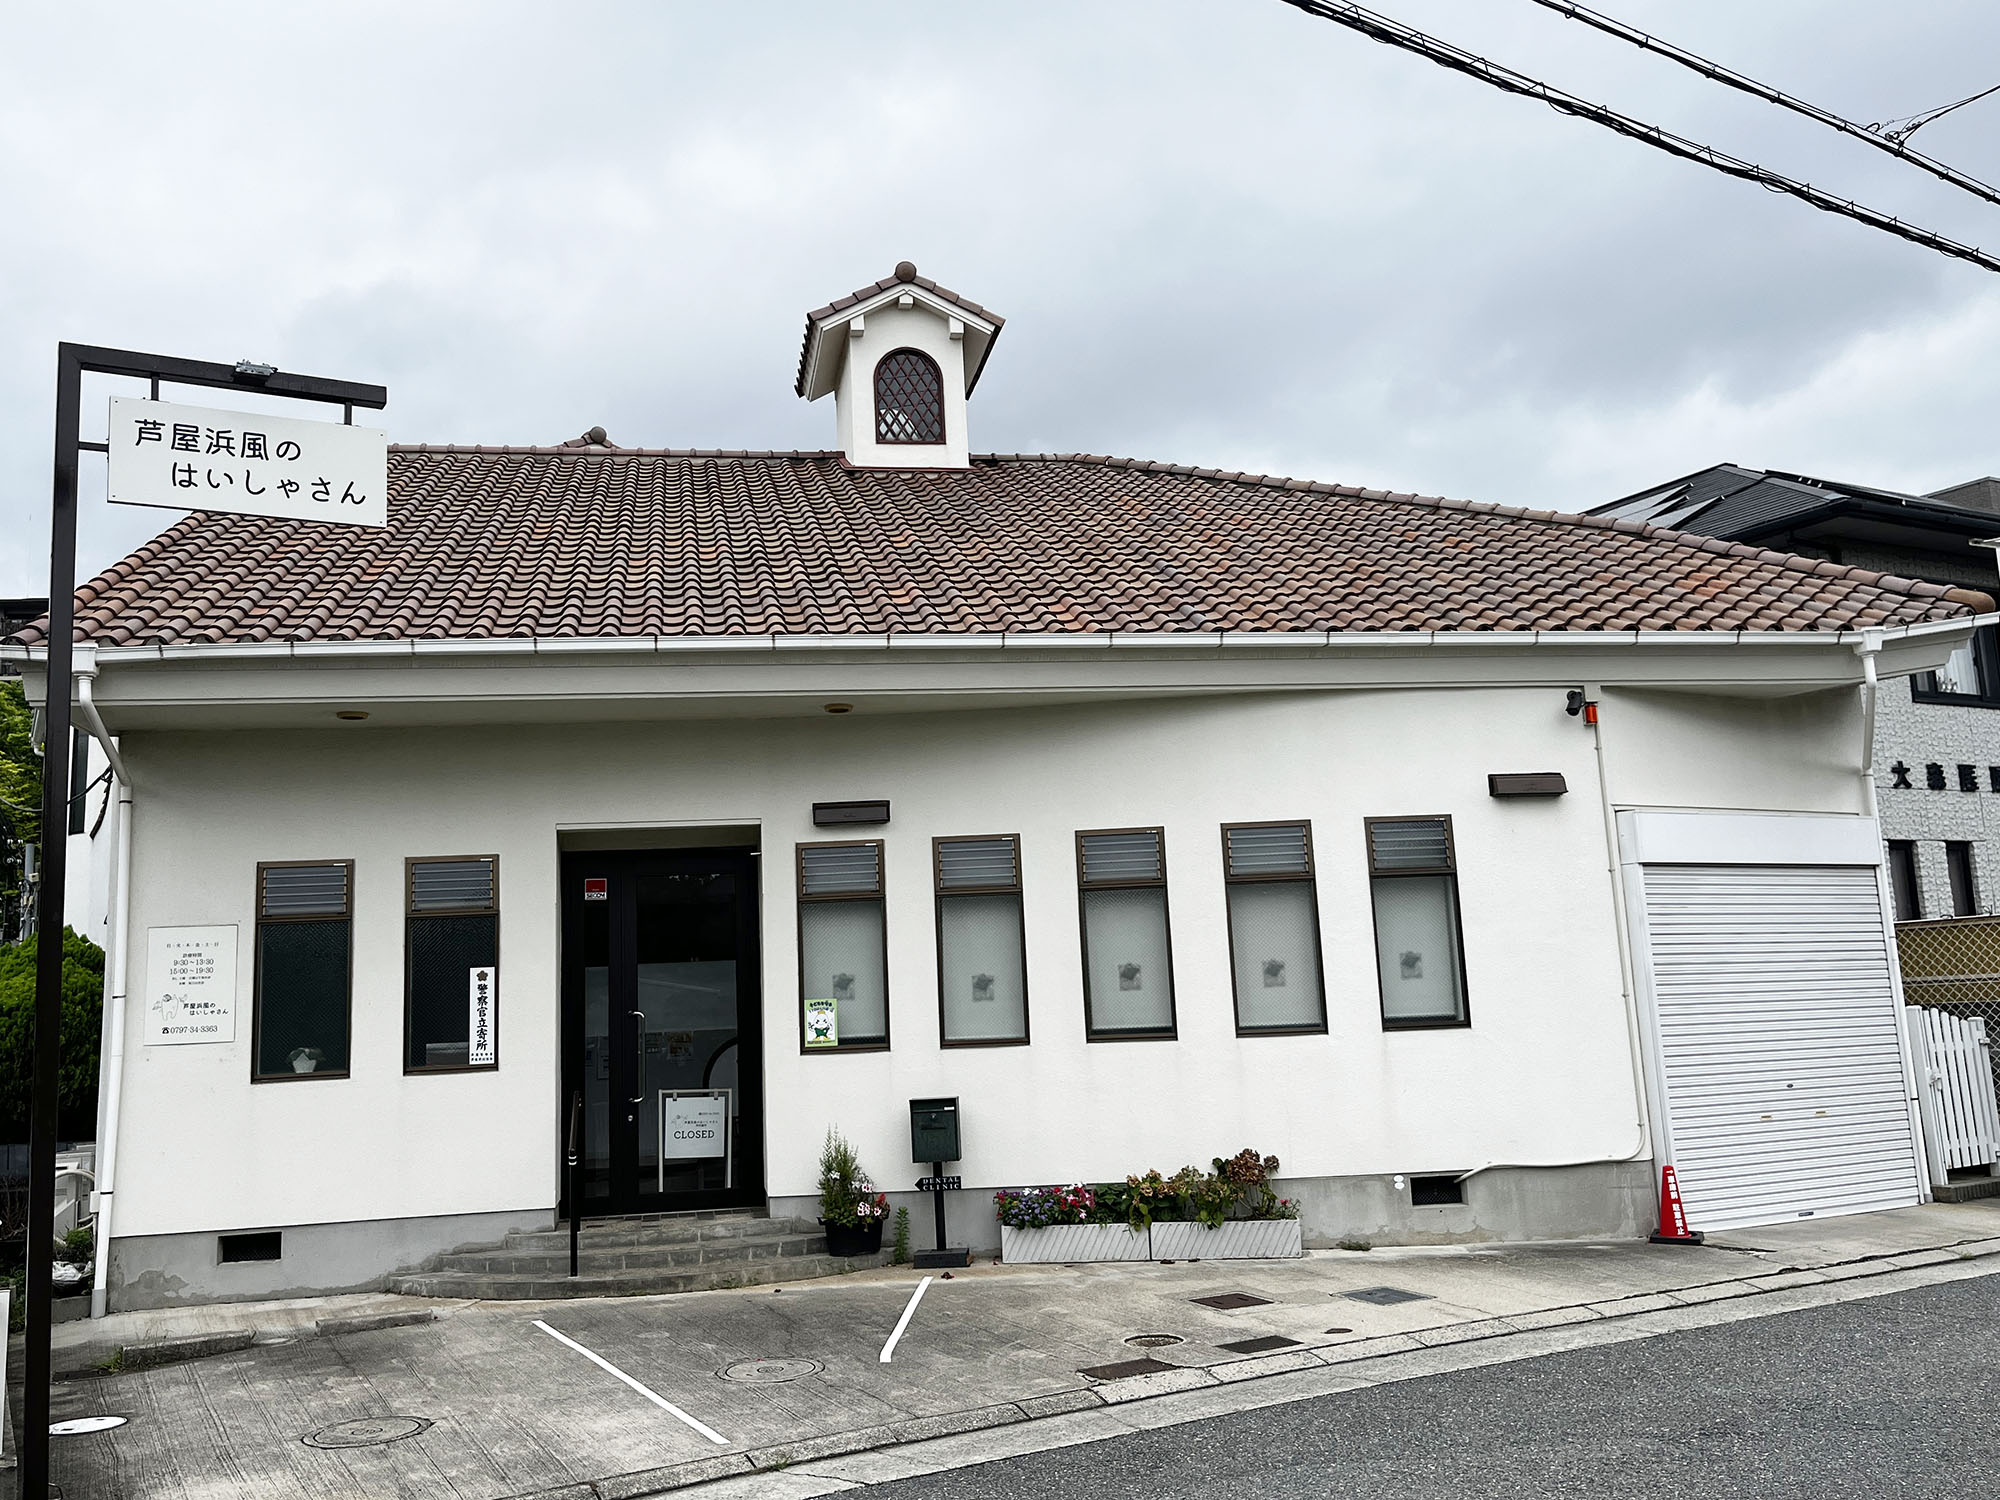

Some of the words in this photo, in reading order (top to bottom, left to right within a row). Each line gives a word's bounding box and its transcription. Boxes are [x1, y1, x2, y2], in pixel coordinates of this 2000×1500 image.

[134, 418, 301, 461] 芦屋浜風の
[171, 462, 366, 505] はいしゃさん
[476, 983, 488, 1051] 警察官立寄所
[673, 1130, 715, 1139] CLOSED
